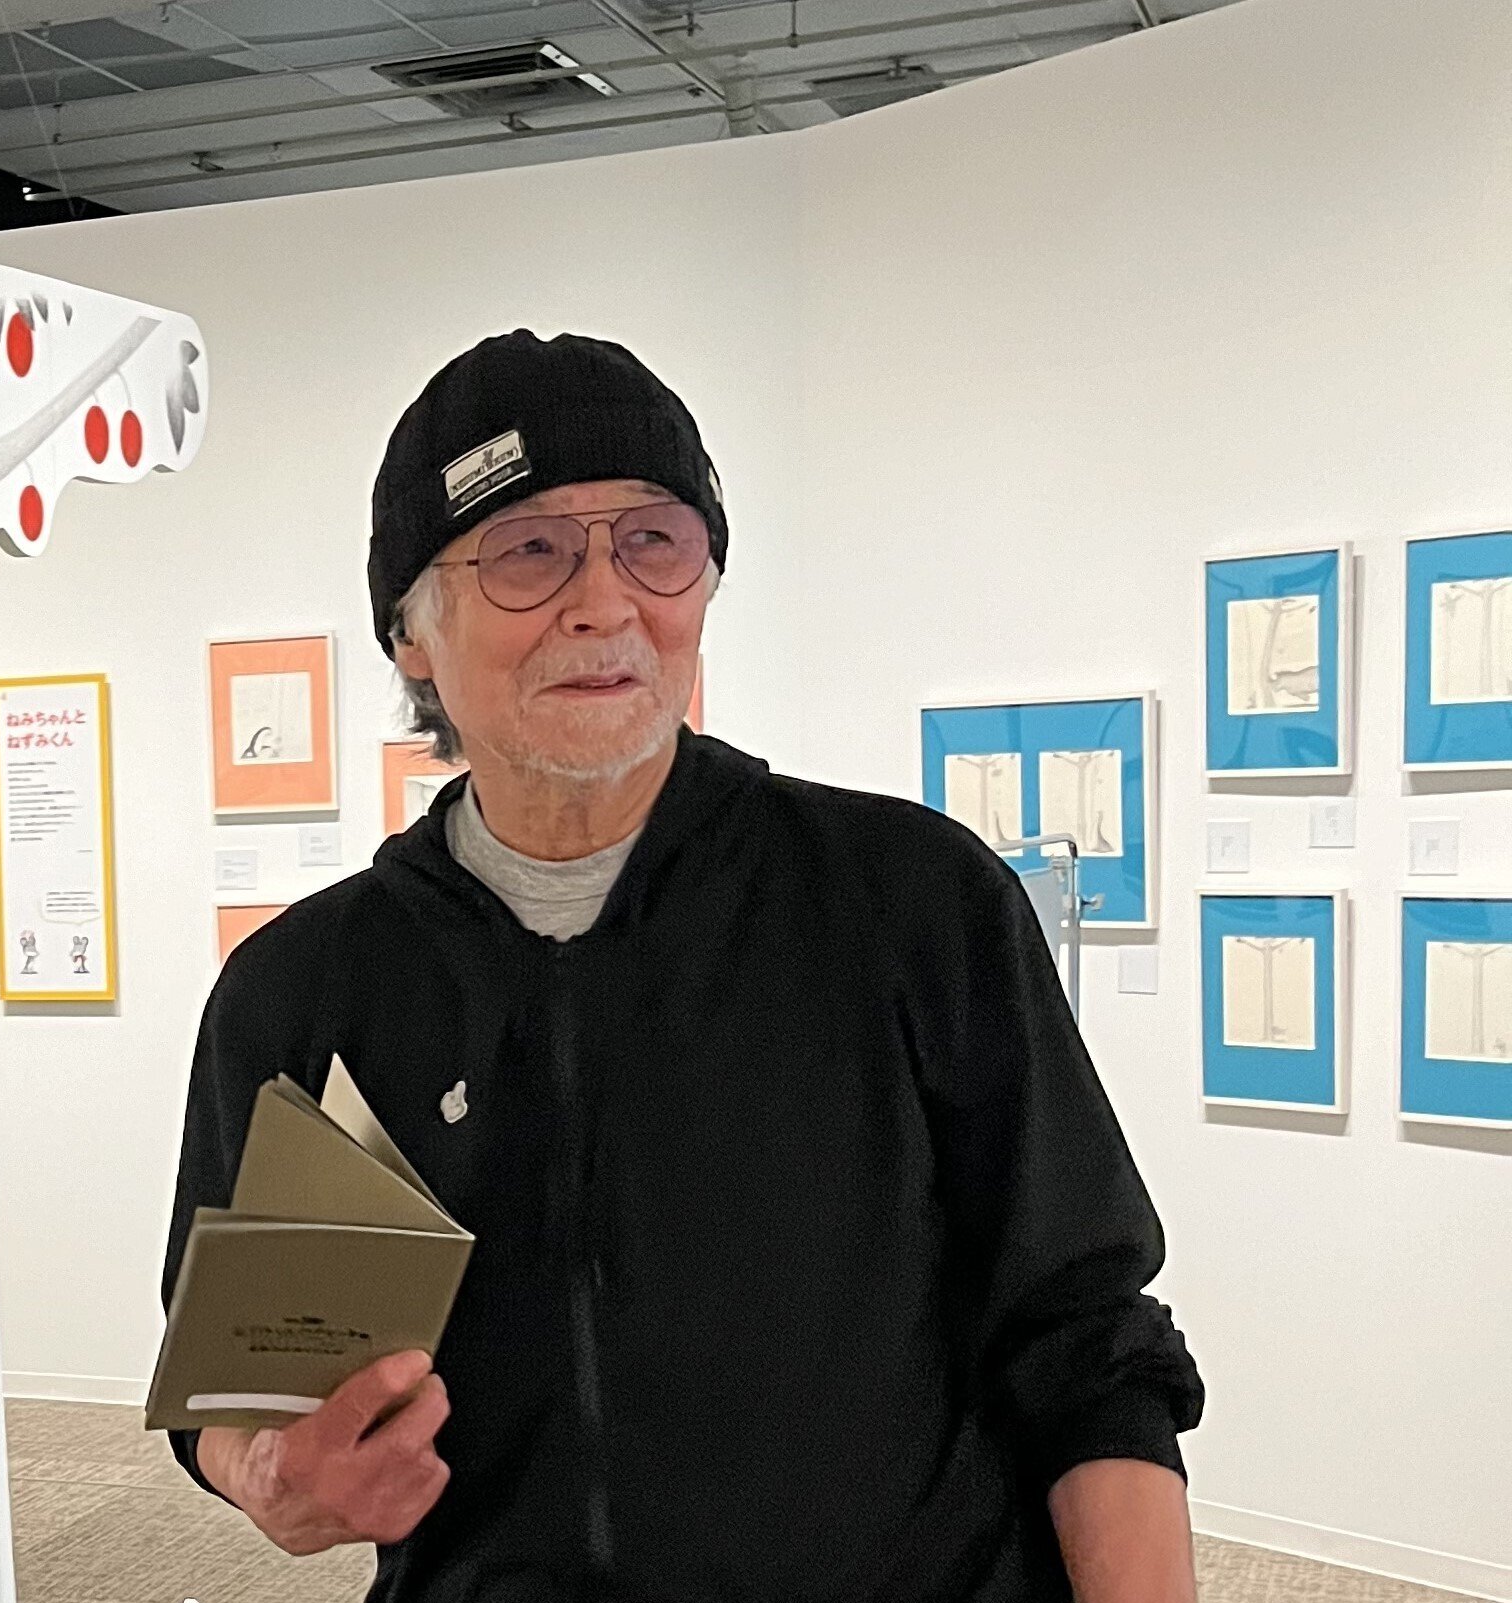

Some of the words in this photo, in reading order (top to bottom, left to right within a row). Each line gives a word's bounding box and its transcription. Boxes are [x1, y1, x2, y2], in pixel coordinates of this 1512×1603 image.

[6, 709, 86, 727] ねみちゃんと
[7, 731, 75, 749] ねずみくん
